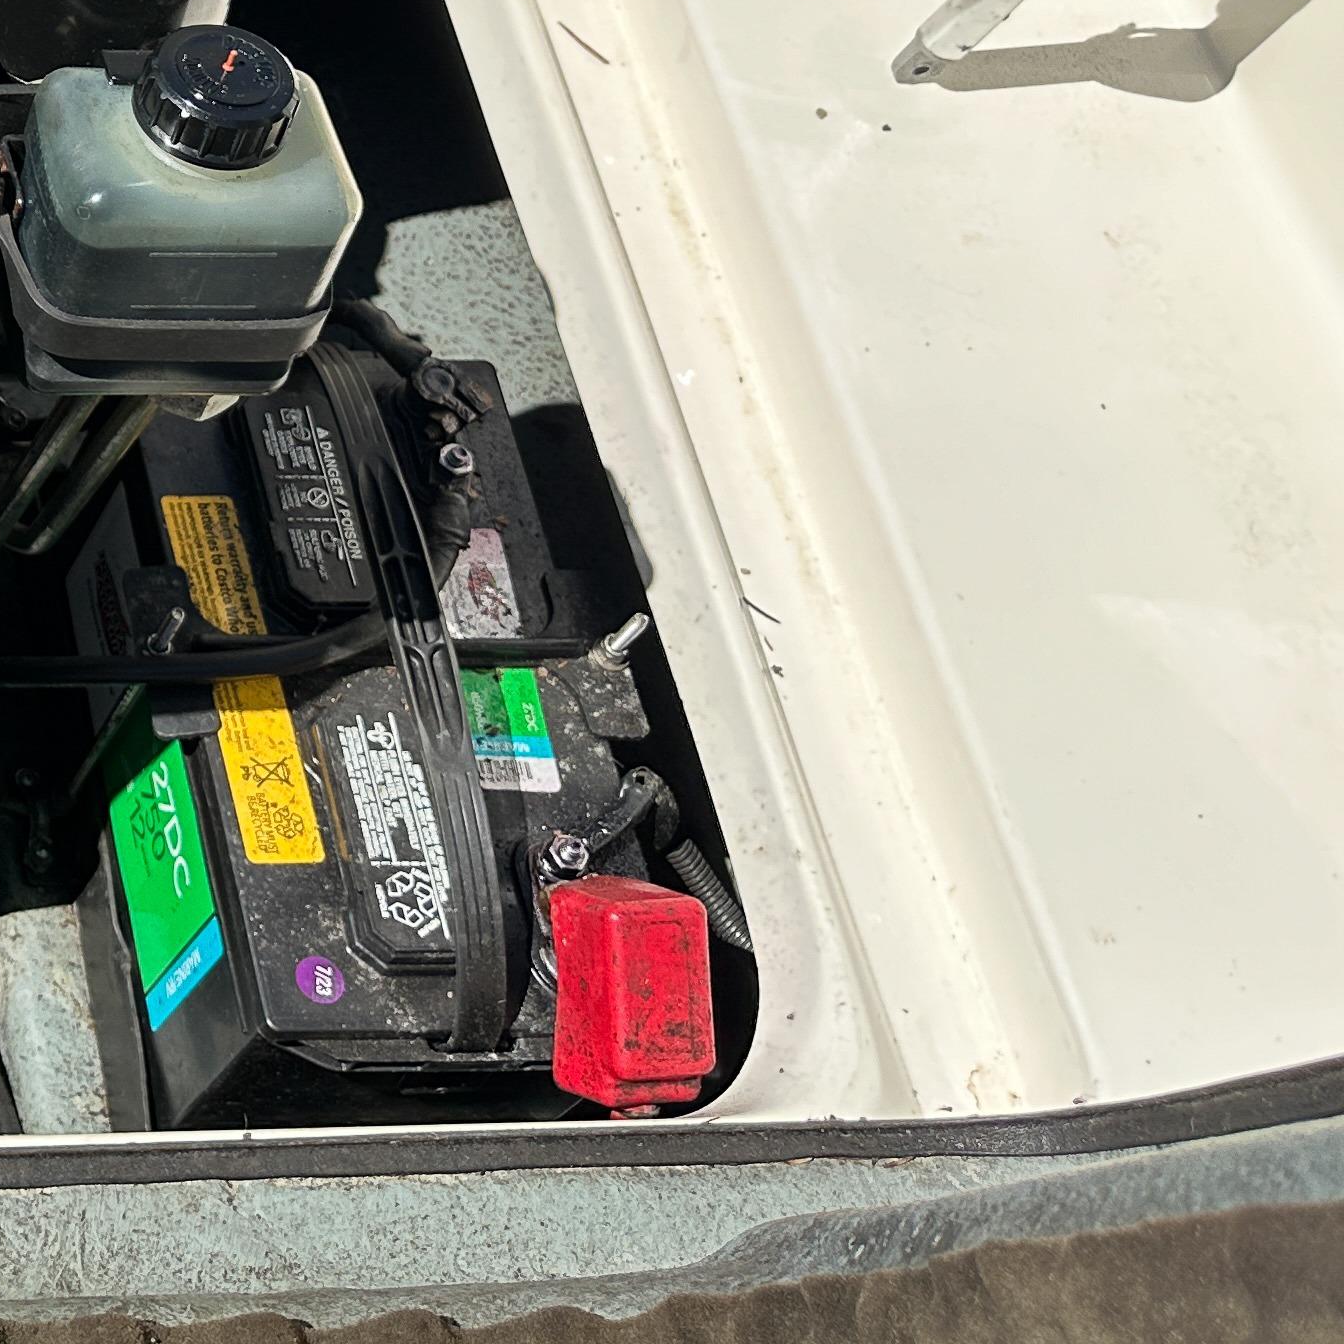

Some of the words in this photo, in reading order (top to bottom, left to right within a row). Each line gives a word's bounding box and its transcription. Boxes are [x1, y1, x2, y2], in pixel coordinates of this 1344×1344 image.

[318, 440, 345, 495] DANGER
[337, 509, 362, 559] POISON
[212, 553, 225, 565] to
[140, 779, 170, 862] 750
[147, 760, 194, 899] 27DC
[313, 965, 332, 995] 7/23
